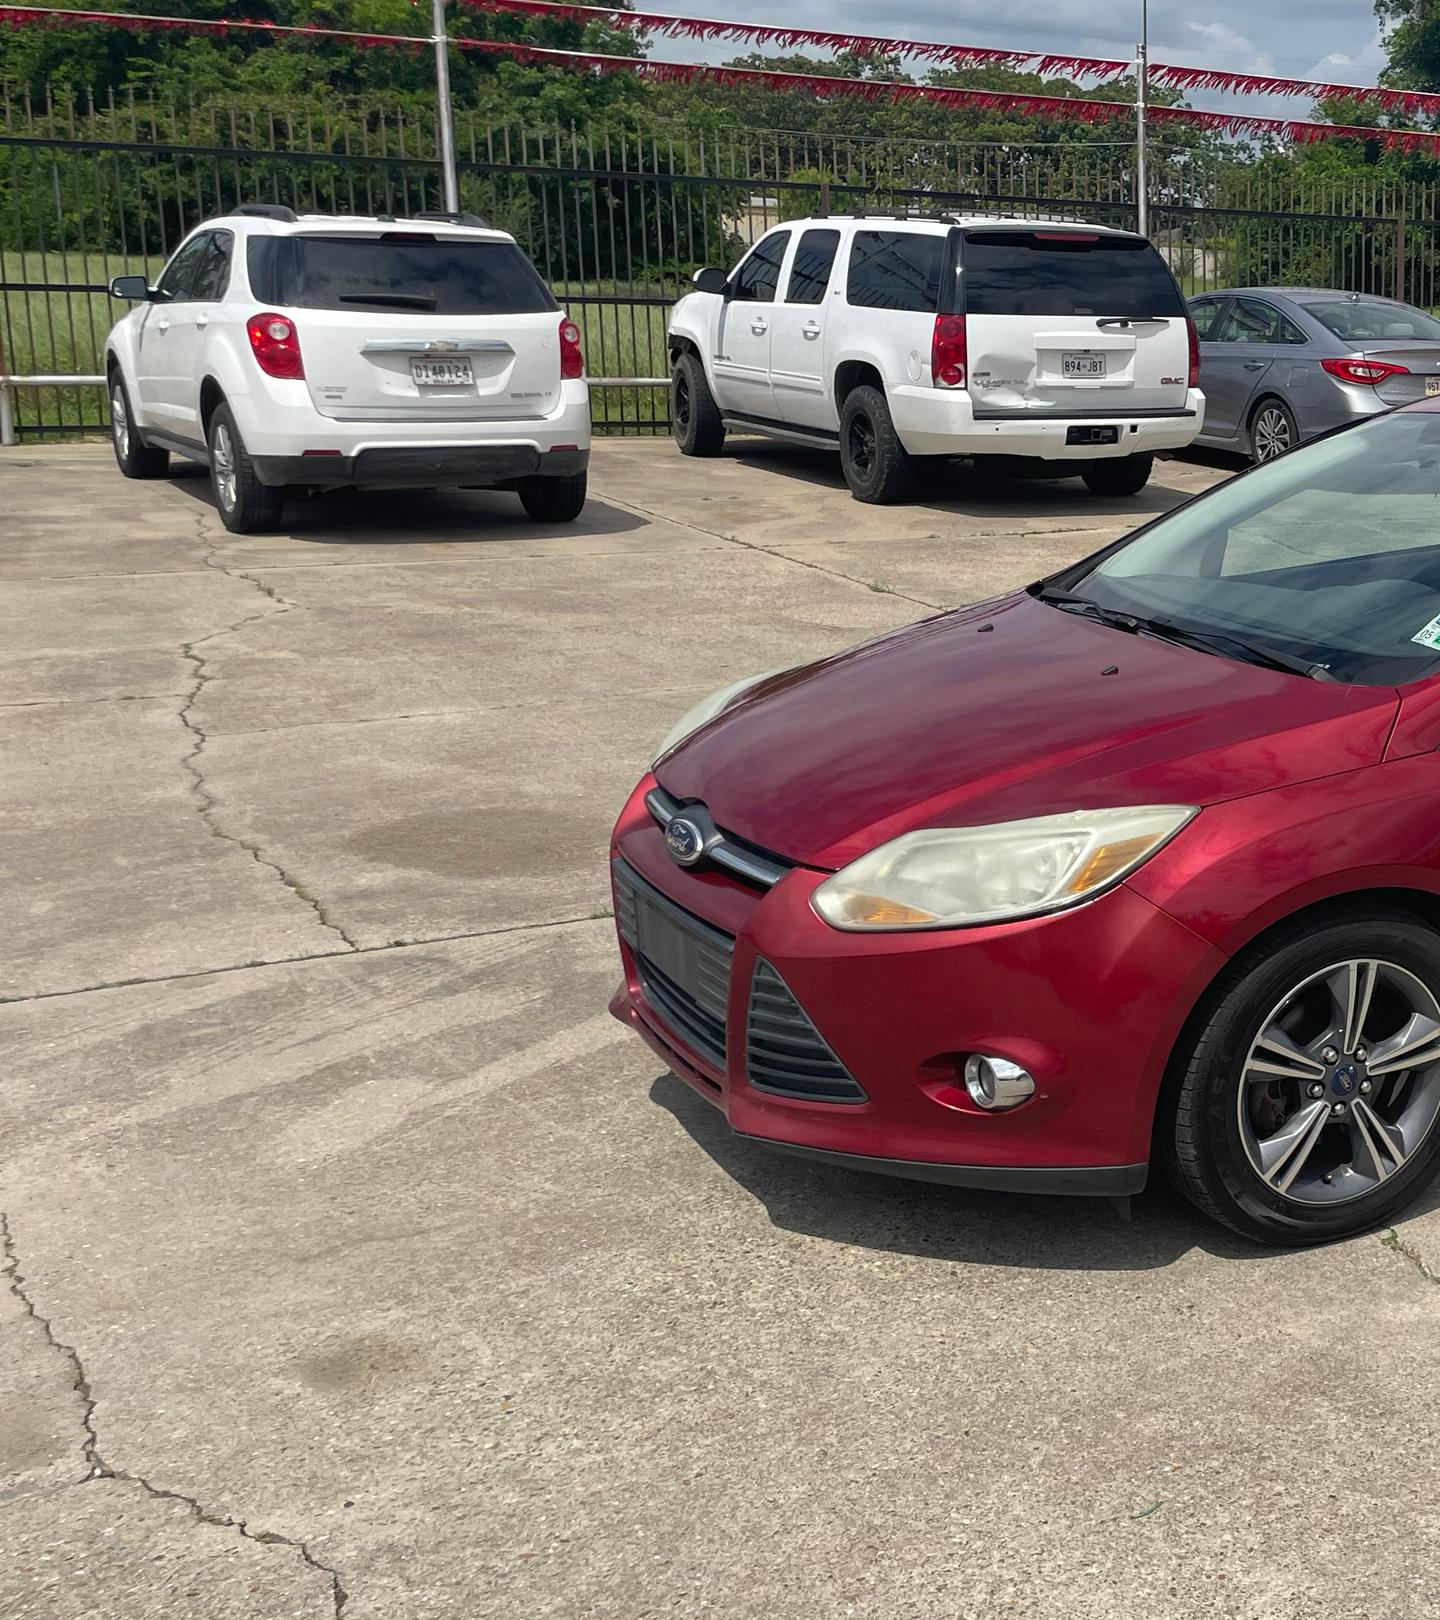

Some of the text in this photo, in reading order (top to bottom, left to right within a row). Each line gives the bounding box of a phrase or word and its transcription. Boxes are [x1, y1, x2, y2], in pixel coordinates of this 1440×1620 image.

[1064, 360, 1104, 372] 894 JBT
[1160, 377, 1185, 385] GMC
[667, 823, 692, 853] Ford
